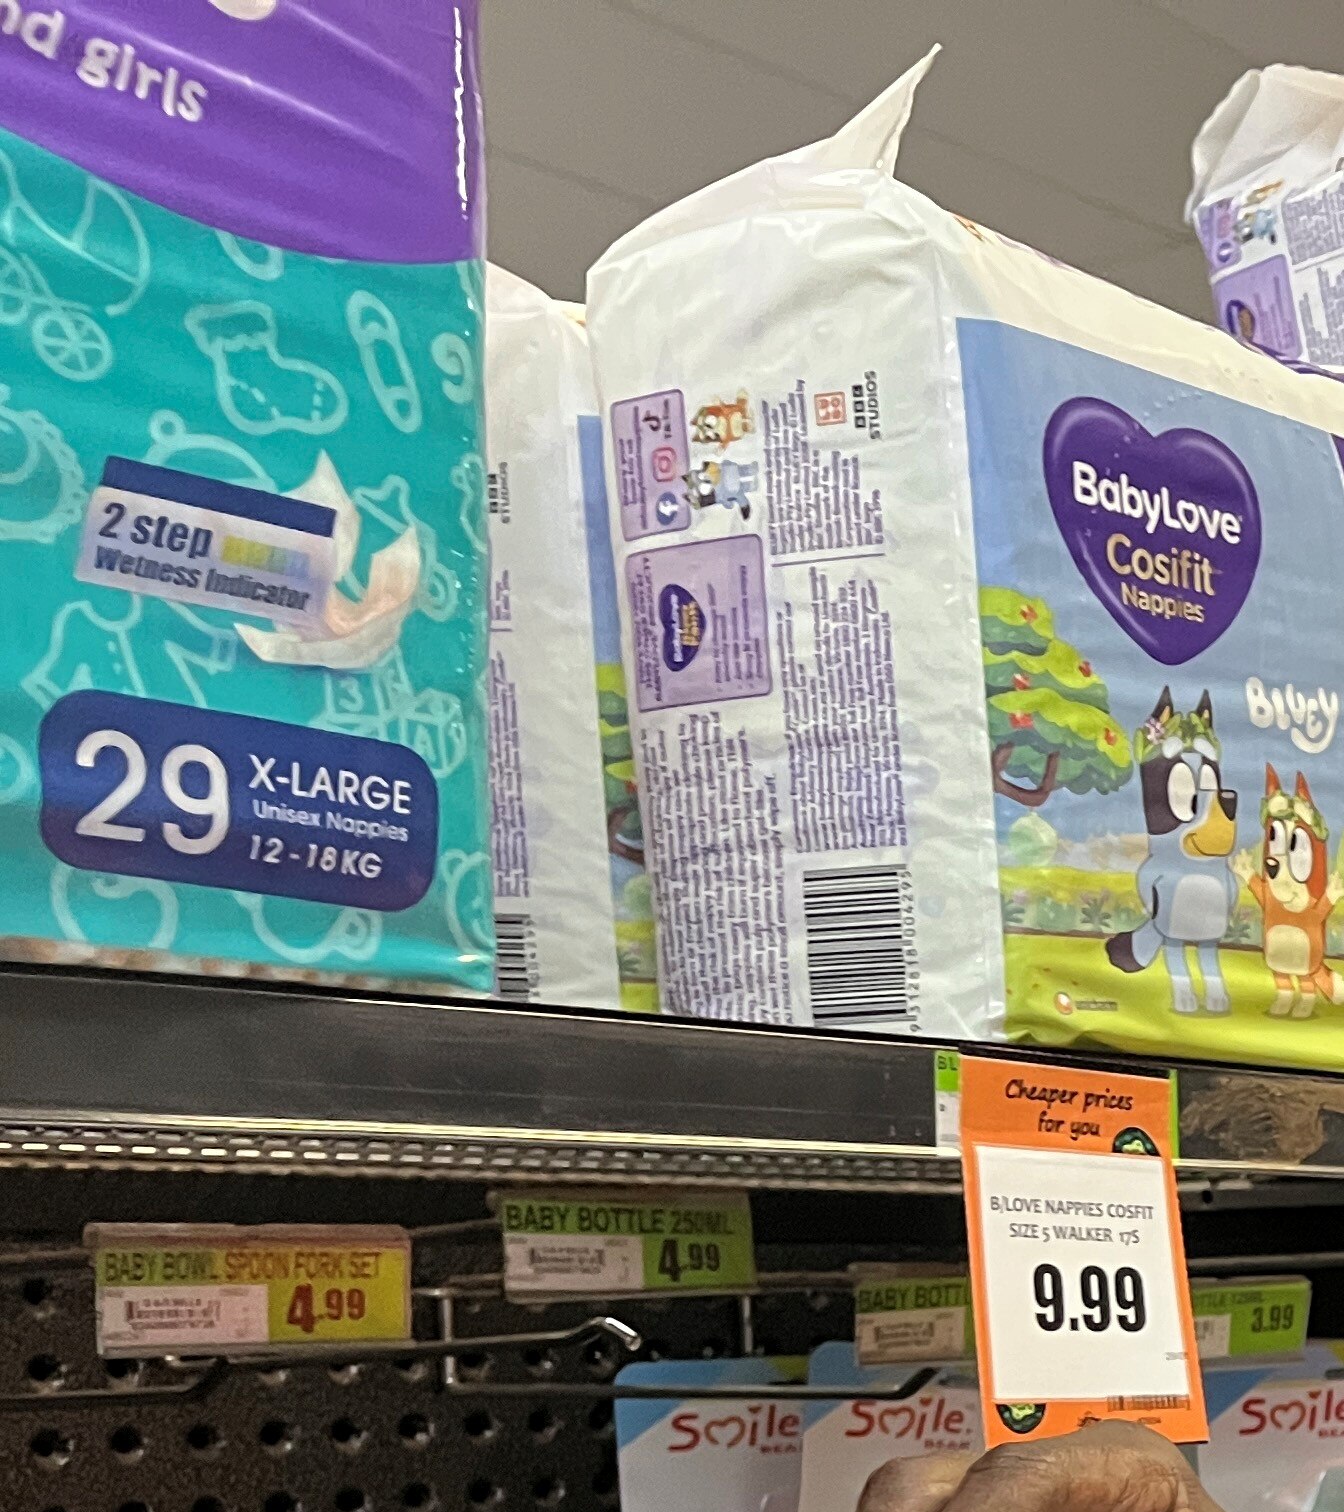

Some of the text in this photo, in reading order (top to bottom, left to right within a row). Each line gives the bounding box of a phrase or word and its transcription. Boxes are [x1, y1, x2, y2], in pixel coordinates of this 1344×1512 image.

[76, 37, 208, 122] girls
[865, 371, 881, 440] STUDIOS
[1072, 461, 1242, 544] BabyLove
[97, 502, 214, 560] 2 step
[94, 545, 312, 613] Wetness Indicator
[1107, 533, 1216, 596] Cosifit
[1121, 582, 1204, 623] Nappies
[74, 728, 230, 855] 29
[248, 753, 412, 815] X-LARGE
[252, 799, 409, 842] Unisex Nappies
[1005, 1079, 1133, 1112] Cheaper prices
[1038, 1111, 1101, 1141] for you
[505, 1203, 570, 1232] BABY
[576, 1206, 665, 1235] BOTTLE
[1045, 1200, 1105, 1218] NAPPIES
[1009, 1222, 1039, 1239] SIZE
[1042, 1226, 1050, 1244] 5
[1053, 1225, 1114, 1243] WALKER
[104, 1250, 383, 1282] BABY BOWL SPOON FORK SET
[658, 1238, 722, 1283] 4.99
[286, 1283, 367, 1334] 4.99
[859, 1289, 910, 1315] BABY
[1033, 1263, 1147, 1332] 9.99
[1251, 1303, 1295, 1333] 3.99
